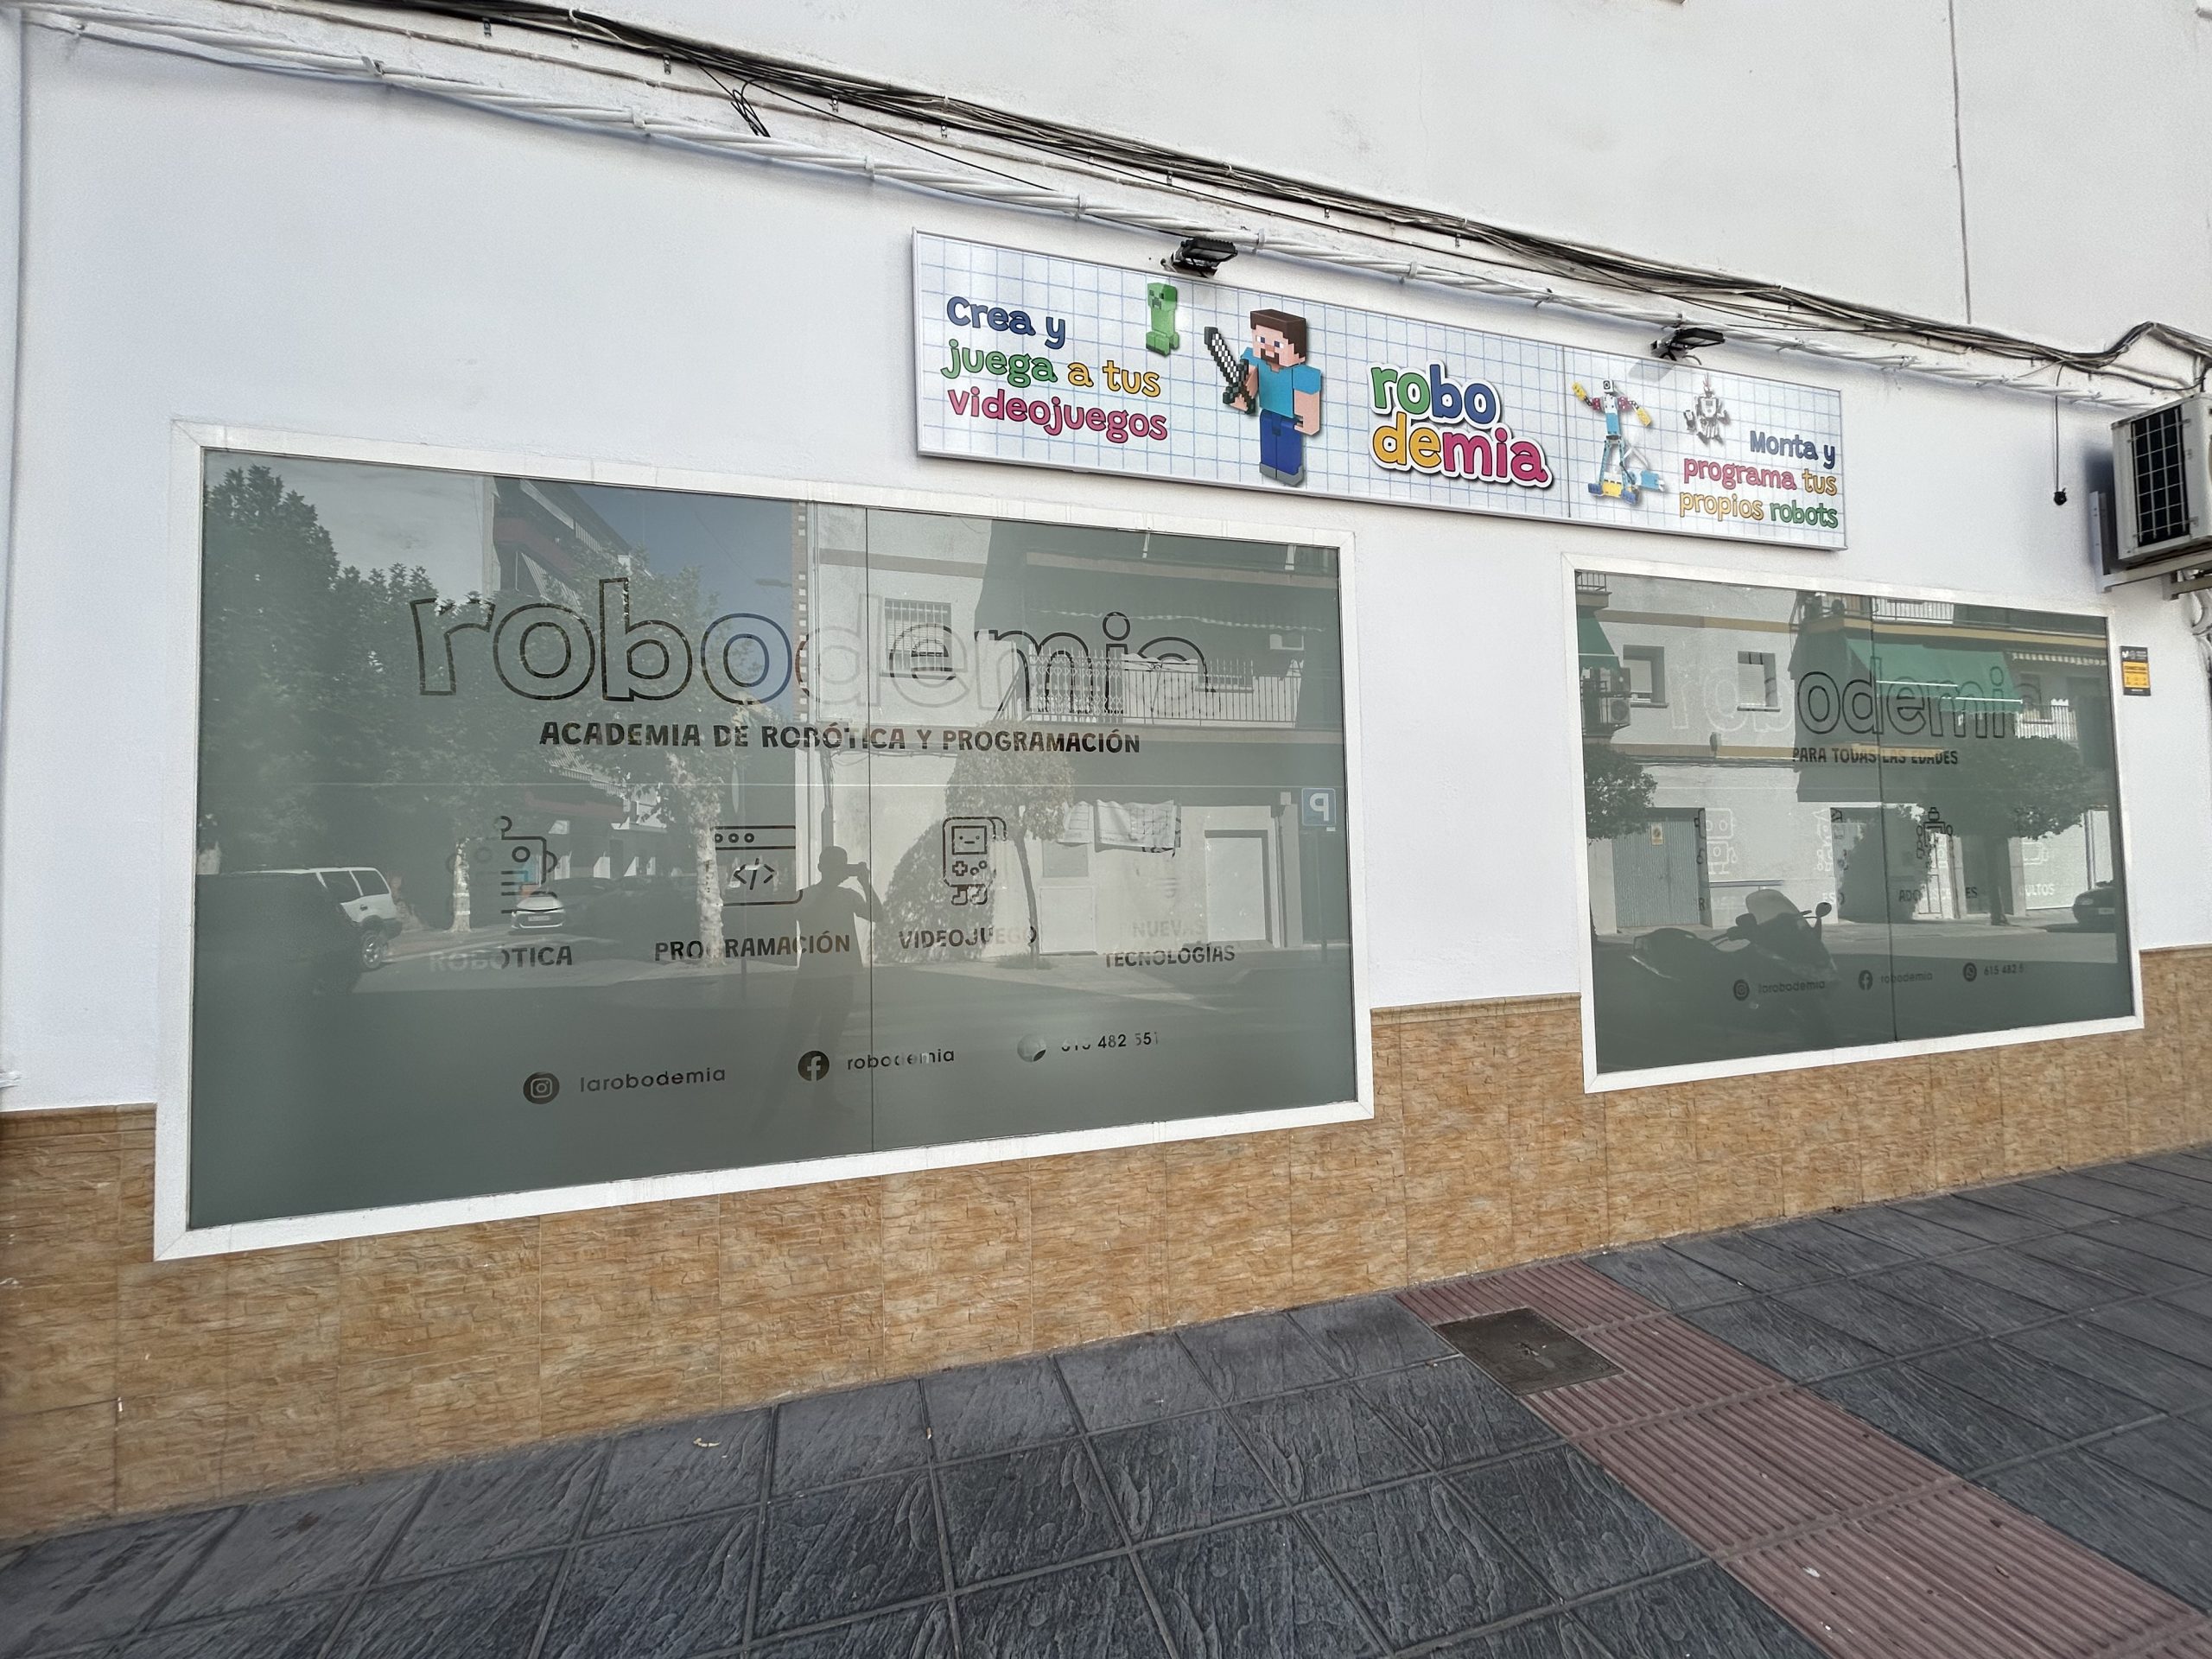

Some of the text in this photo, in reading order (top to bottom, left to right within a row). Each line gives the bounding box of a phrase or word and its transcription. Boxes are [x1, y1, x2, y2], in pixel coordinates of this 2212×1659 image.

[946, 296, 1066, 350] Crea y
[940, 338, 1161, 397] juega a tus
[1370, 363, 1497, 425] robo
[948, 385, 1168, 444] videojuegos
[1372, 411, 1550, 485] demia
[1750, 430, 1836, 470] Monta y
[1684, 458, 1839, 496] programa tus
[1679, 493, 1840, 530] propios robots
[539, 721, 1141, 753] ACADEMIA DE ROBÓTICA Y PROGRAMACIÓN
[1792, 747, 1827, 763] PARA
[656, 930, 851, 961] PRORAMACIÓN
[1105, 943, 1236, 969] TECNOLOGÍAS
[1097, 1033, 1127, 1048] 482
[580, 1066, 727, 1093] larobodemia
